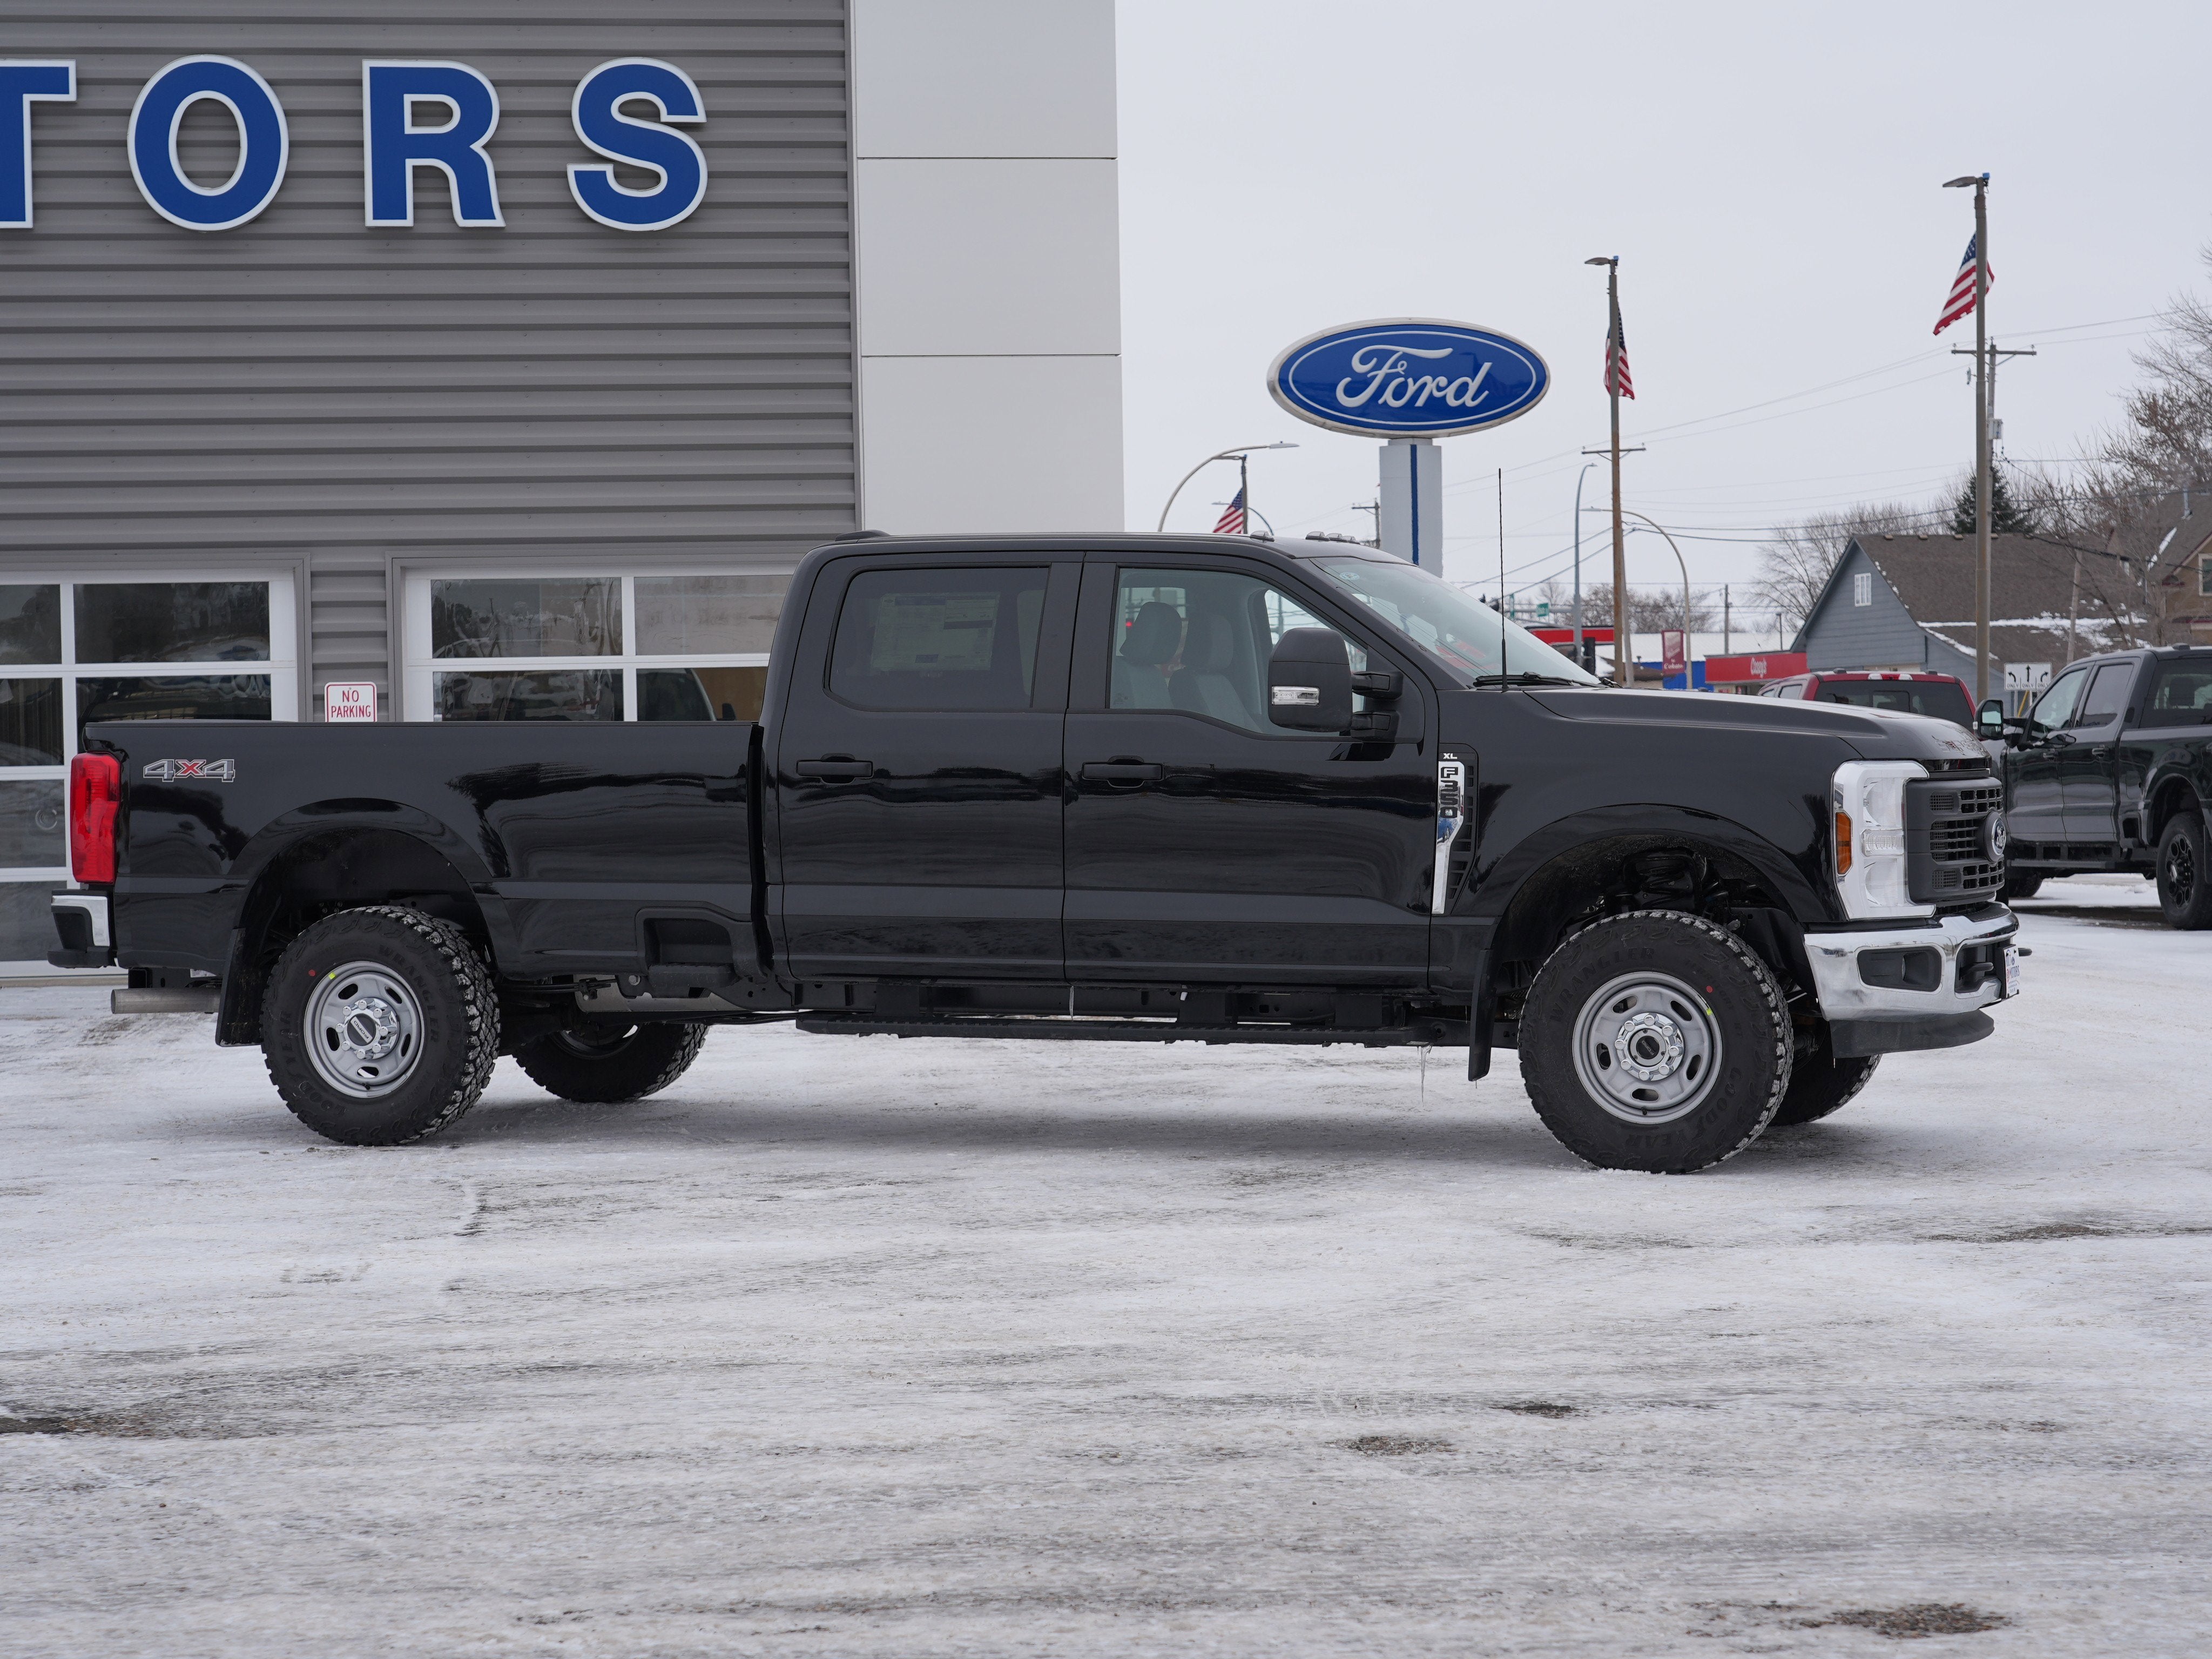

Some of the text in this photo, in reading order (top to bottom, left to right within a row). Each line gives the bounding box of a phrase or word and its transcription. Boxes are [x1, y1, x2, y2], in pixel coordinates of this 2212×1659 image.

[1336, 345, 1493, 407] Ford
[342, 690, 359, 702] NO
[331, 705, 371, 718] PARKING
[1549, 946, 1655, 1022] WRANGLER
[354, 1020, 369, 1039] FORD
